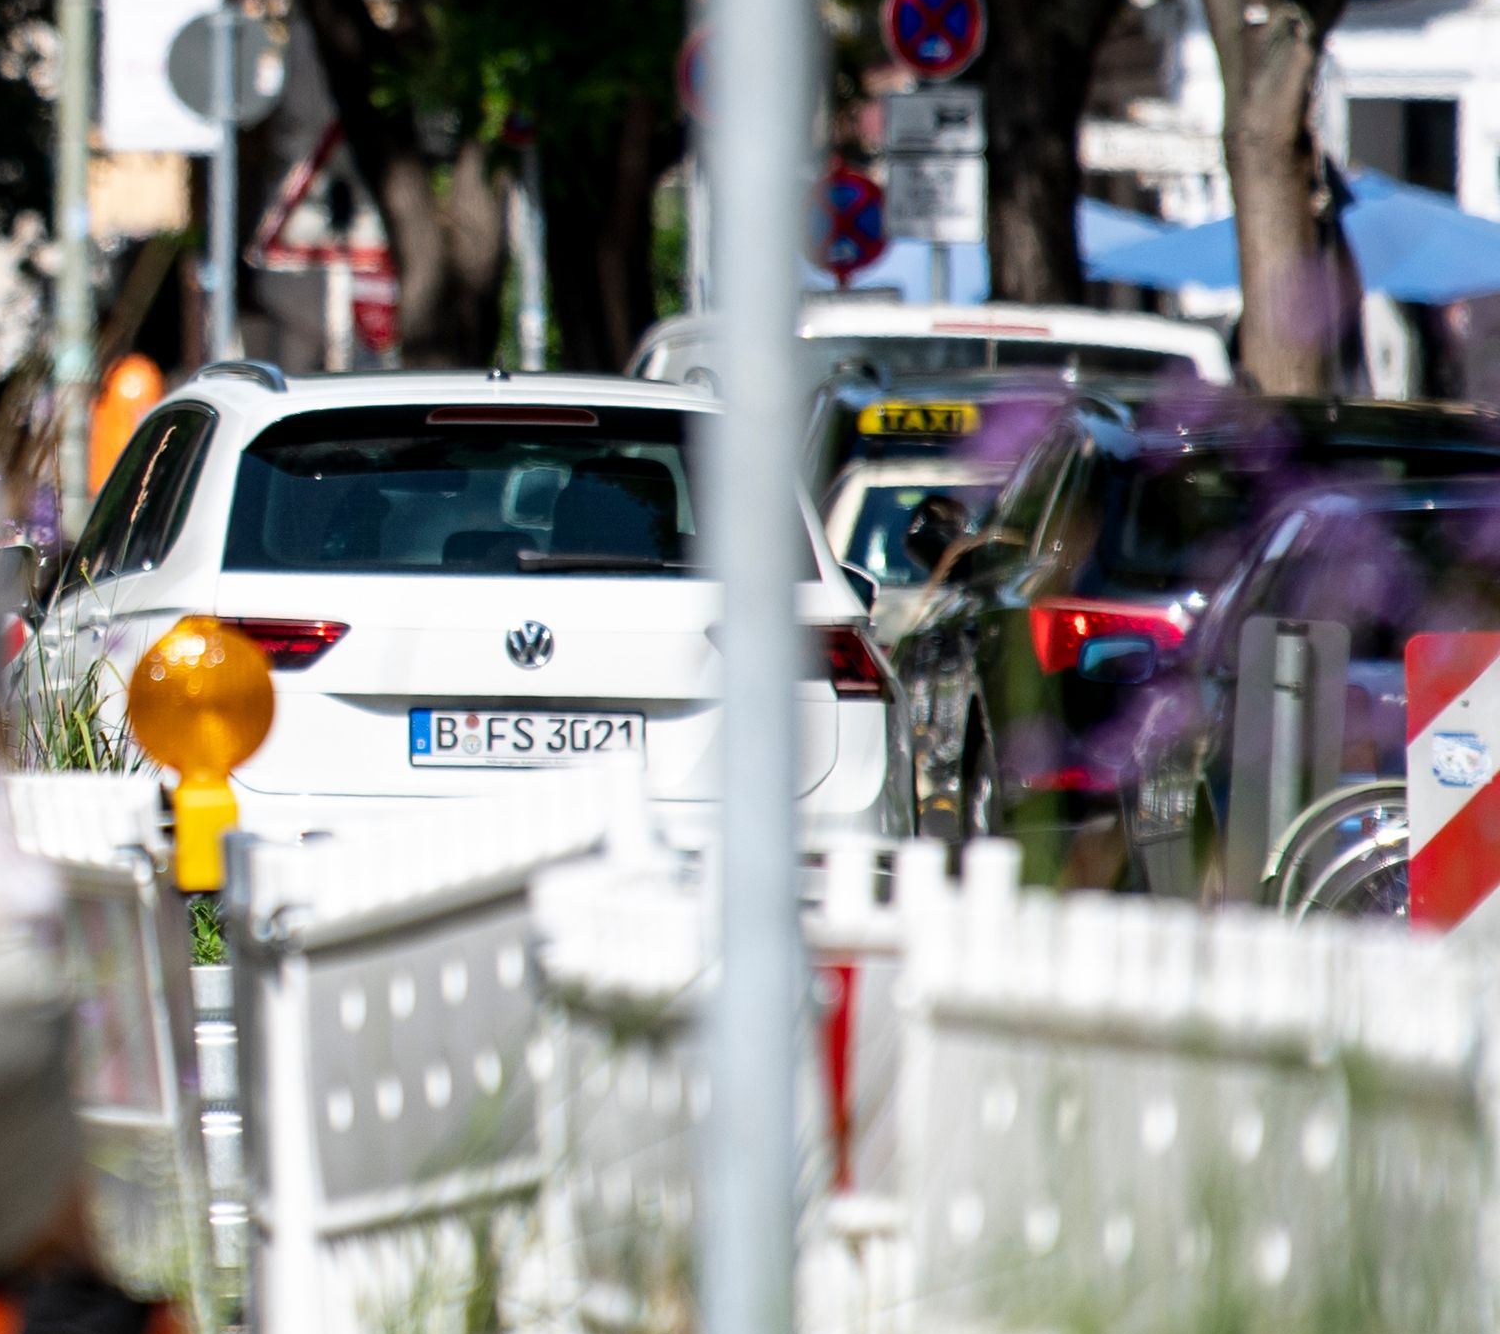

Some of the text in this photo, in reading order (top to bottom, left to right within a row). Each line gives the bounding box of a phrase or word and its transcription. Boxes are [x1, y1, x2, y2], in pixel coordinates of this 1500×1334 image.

[880, 409, 964, 434] TAXI
[436, 717, 631, 753] B FS 3021
